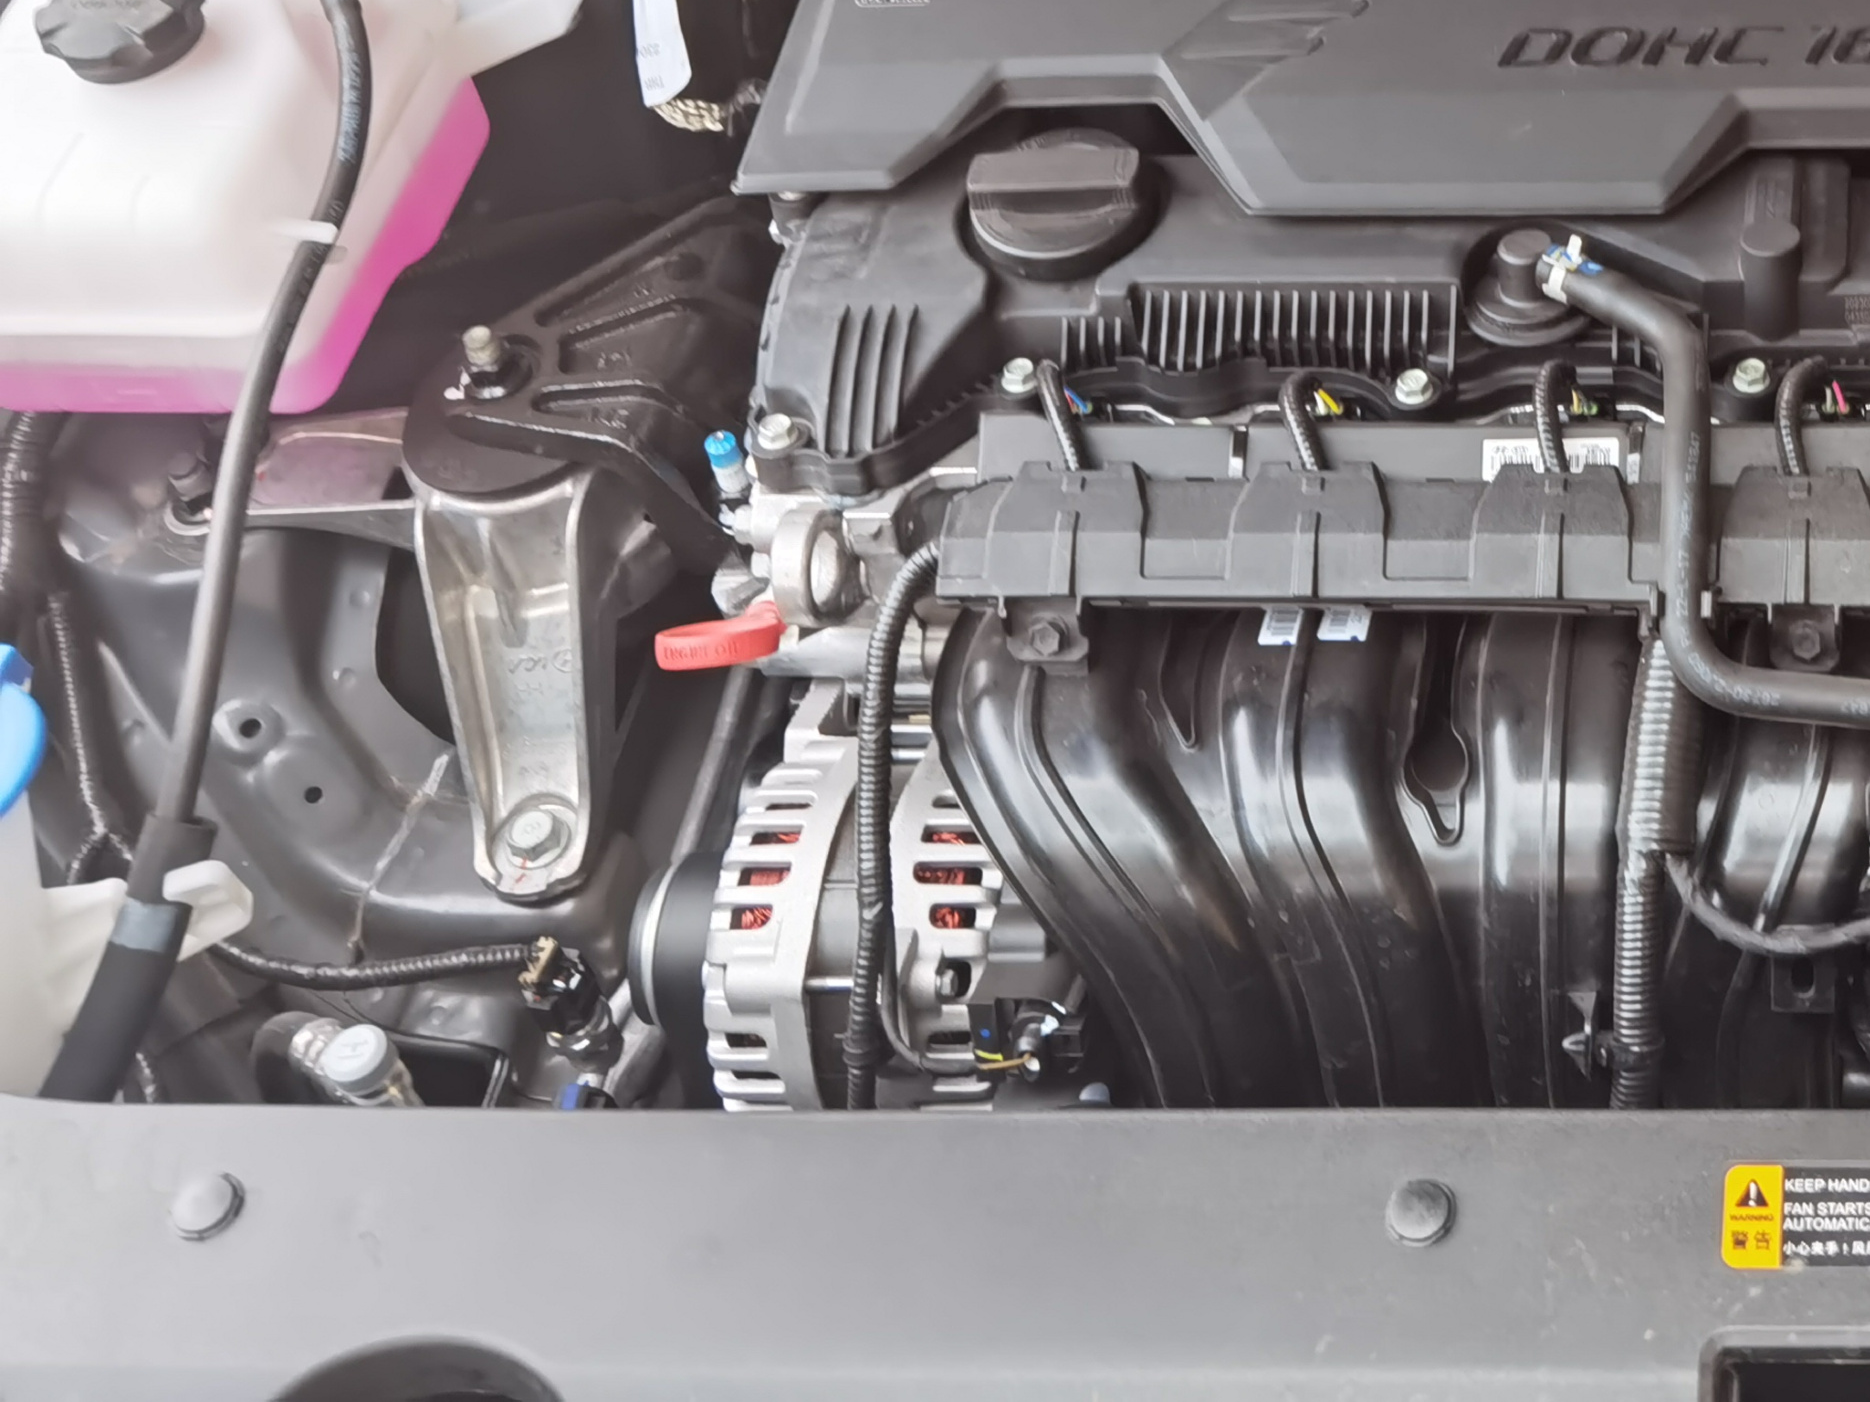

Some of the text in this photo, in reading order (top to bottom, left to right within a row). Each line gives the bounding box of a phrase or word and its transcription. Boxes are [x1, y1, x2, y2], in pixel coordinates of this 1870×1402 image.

[1498, 26, 1785, 66] DOHC
[714, 639, 739, 657] OIL
[1784, 1178, 1826, 1193] KEEP
[1784, 1202, 1814, 1216] FAN
[1730, 1214, 1774, 1222] WARNING
